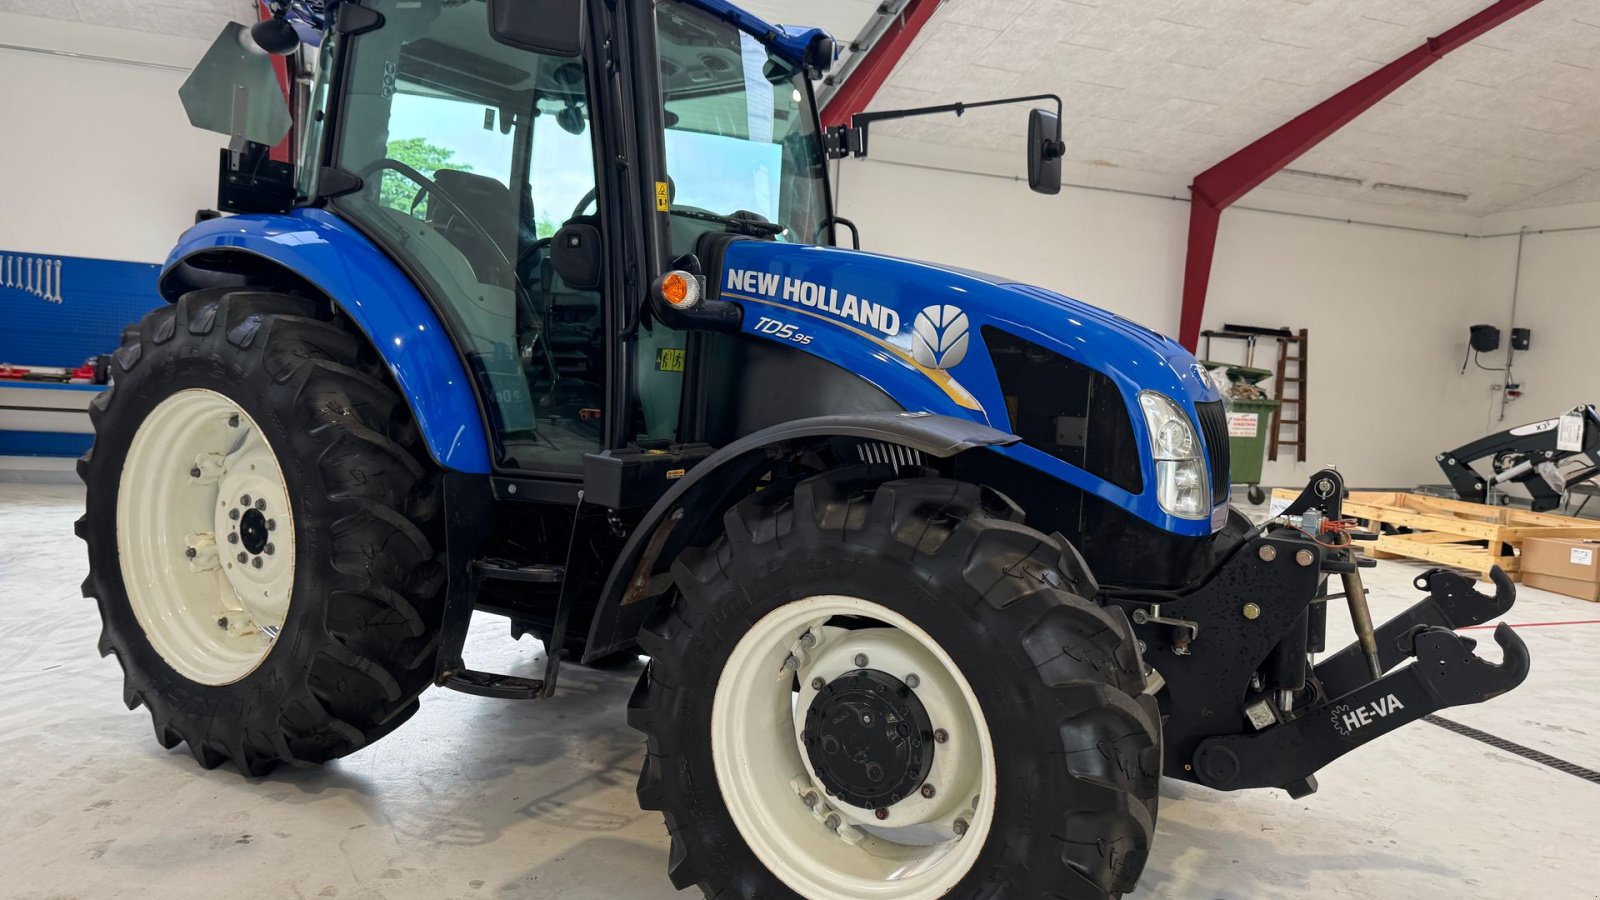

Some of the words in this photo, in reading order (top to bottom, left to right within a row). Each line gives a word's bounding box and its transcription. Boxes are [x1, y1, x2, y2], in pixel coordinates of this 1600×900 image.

[727, 268, 779, 297] NEW
[783, 277, 900, 336] HOLLAND
[1342, 693, 1404, 731] HE-VA
